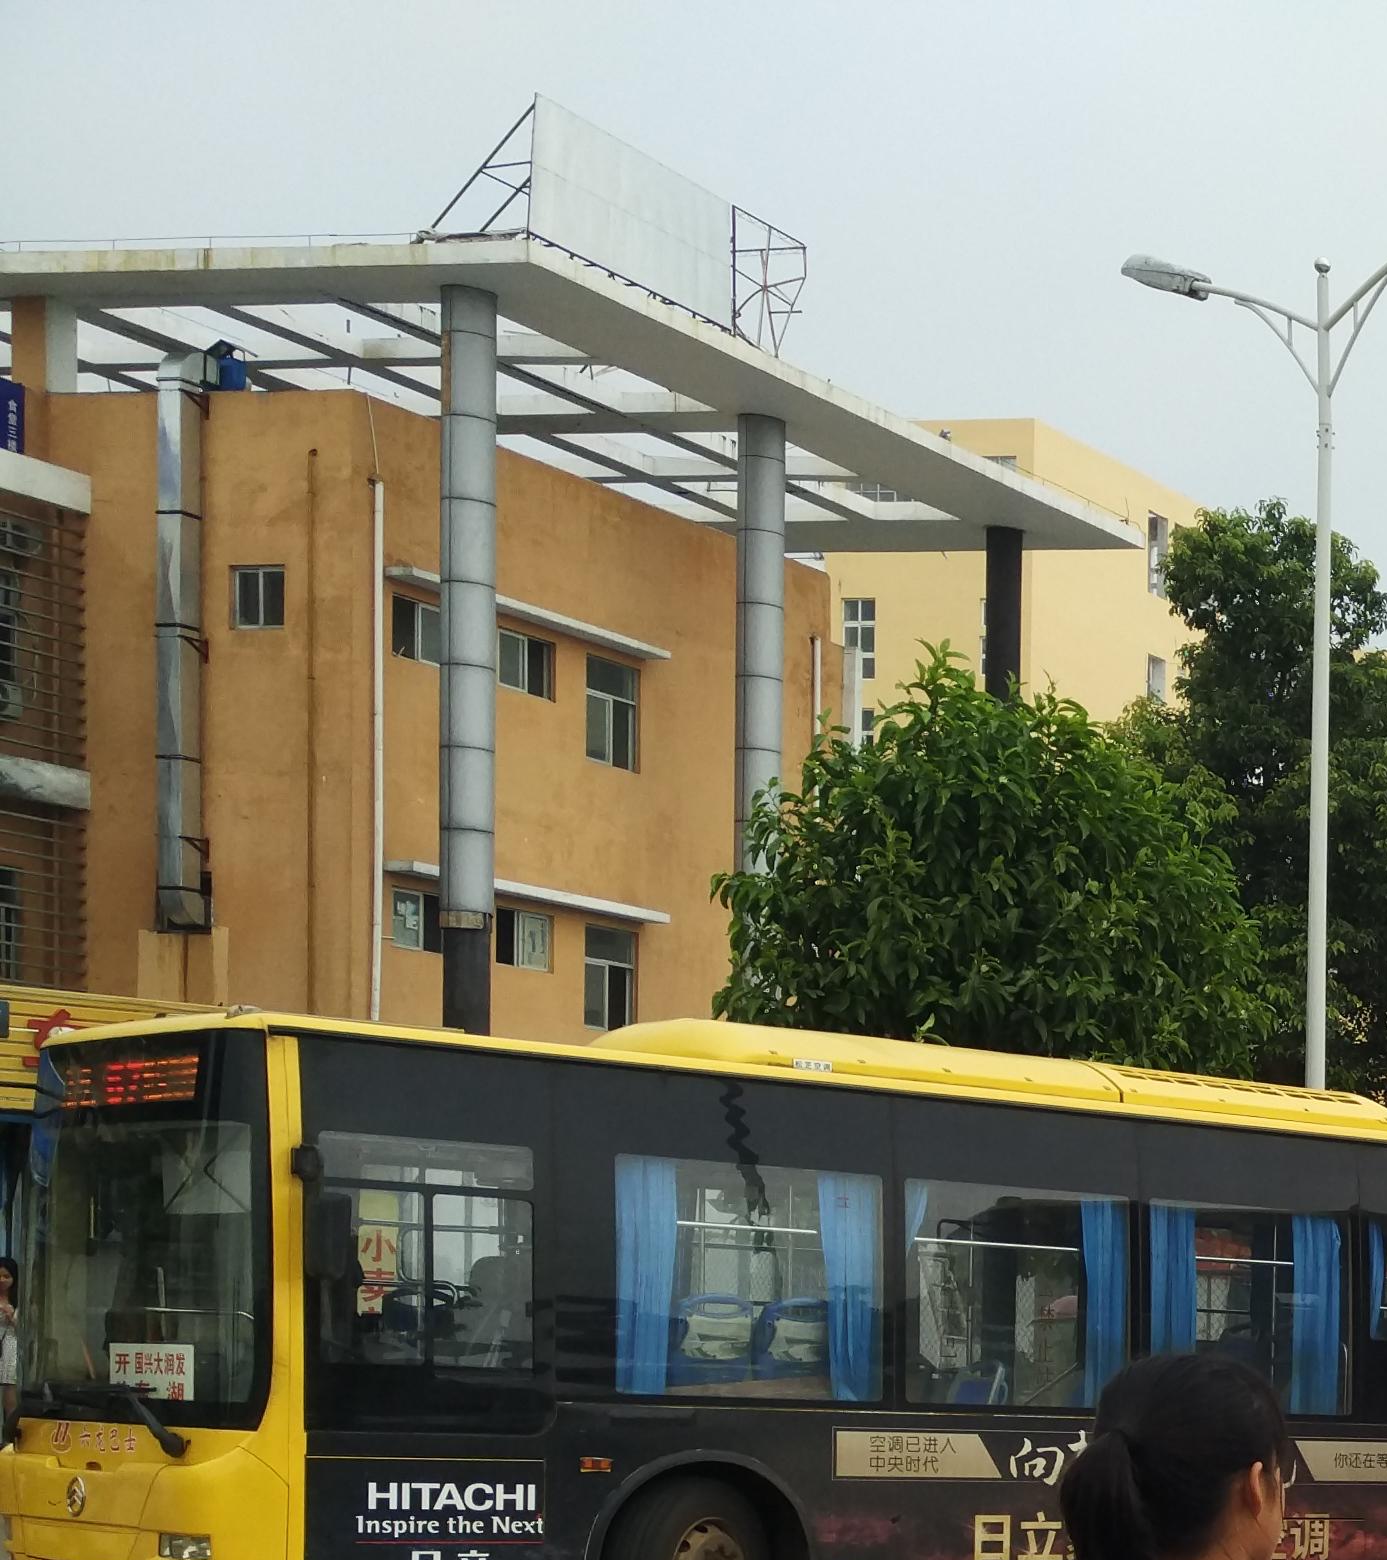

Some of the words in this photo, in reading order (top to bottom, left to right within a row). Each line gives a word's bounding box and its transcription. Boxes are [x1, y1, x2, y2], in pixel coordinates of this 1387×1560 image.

[115, 1354, 130, 1374] 开
[869, 1436, 956, 1455] 空调已进入
[869, 1455, 940, 1474] 中央时代
[367, 1482, 536, 1512] HITACHI
[355, 1515, 440, 1538] Inspire
[447, 1516, 484, 1534] the
[491, 1516, 545, 1534] Next
